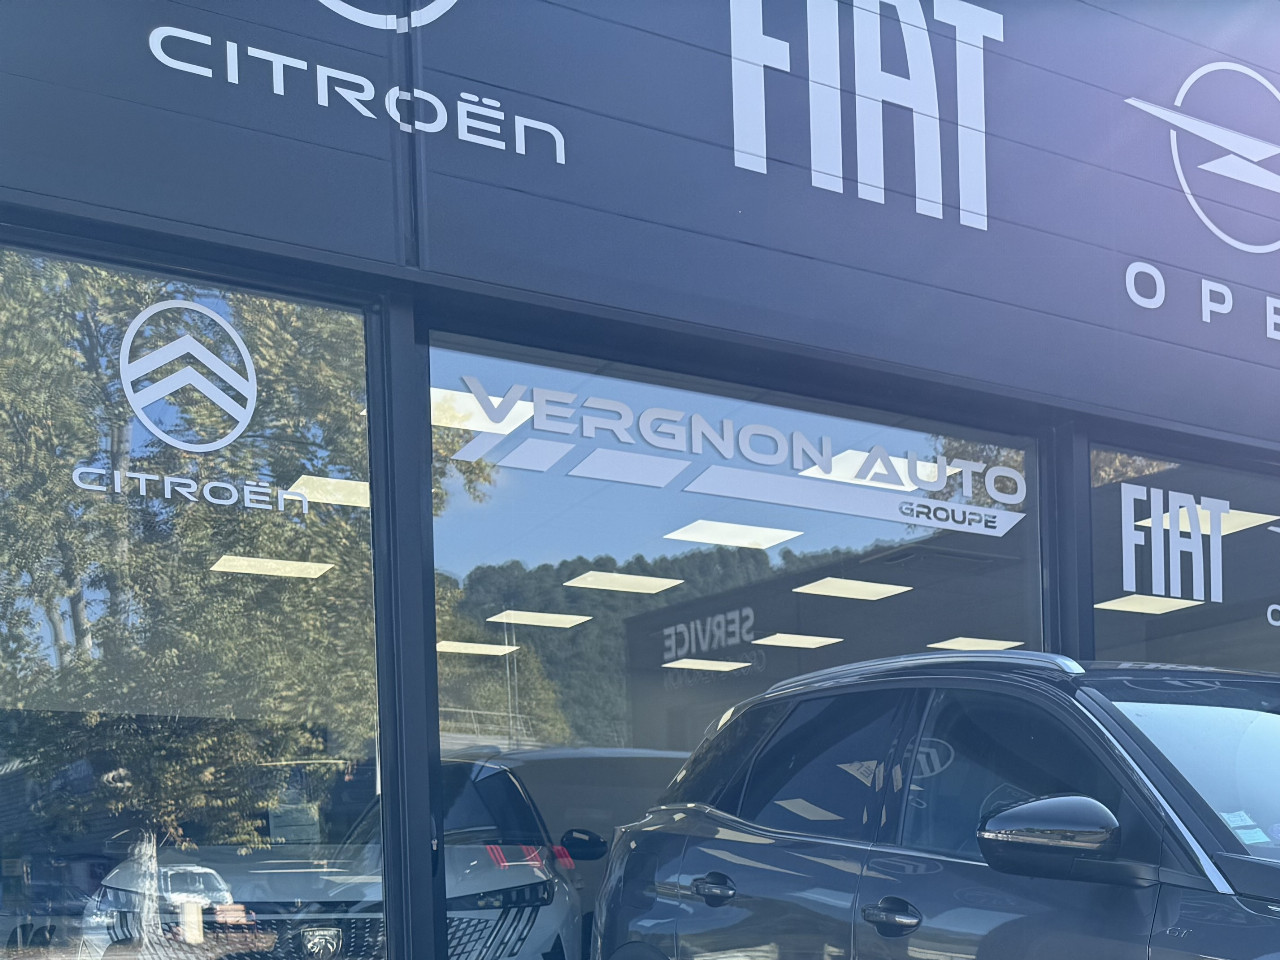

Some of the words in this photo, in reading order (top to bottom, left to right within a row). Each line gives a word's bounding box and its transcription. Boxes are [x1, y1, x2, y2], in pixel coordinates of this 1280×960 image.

[730, 0, 1004, 231] FIAT
[461, 375, 832, 475] VERGNON
[854, 445, 1027, 505] AUTO
[898, 501, 998, 530] GROUPE
[1121, 482, 1230, 603] FIAT
